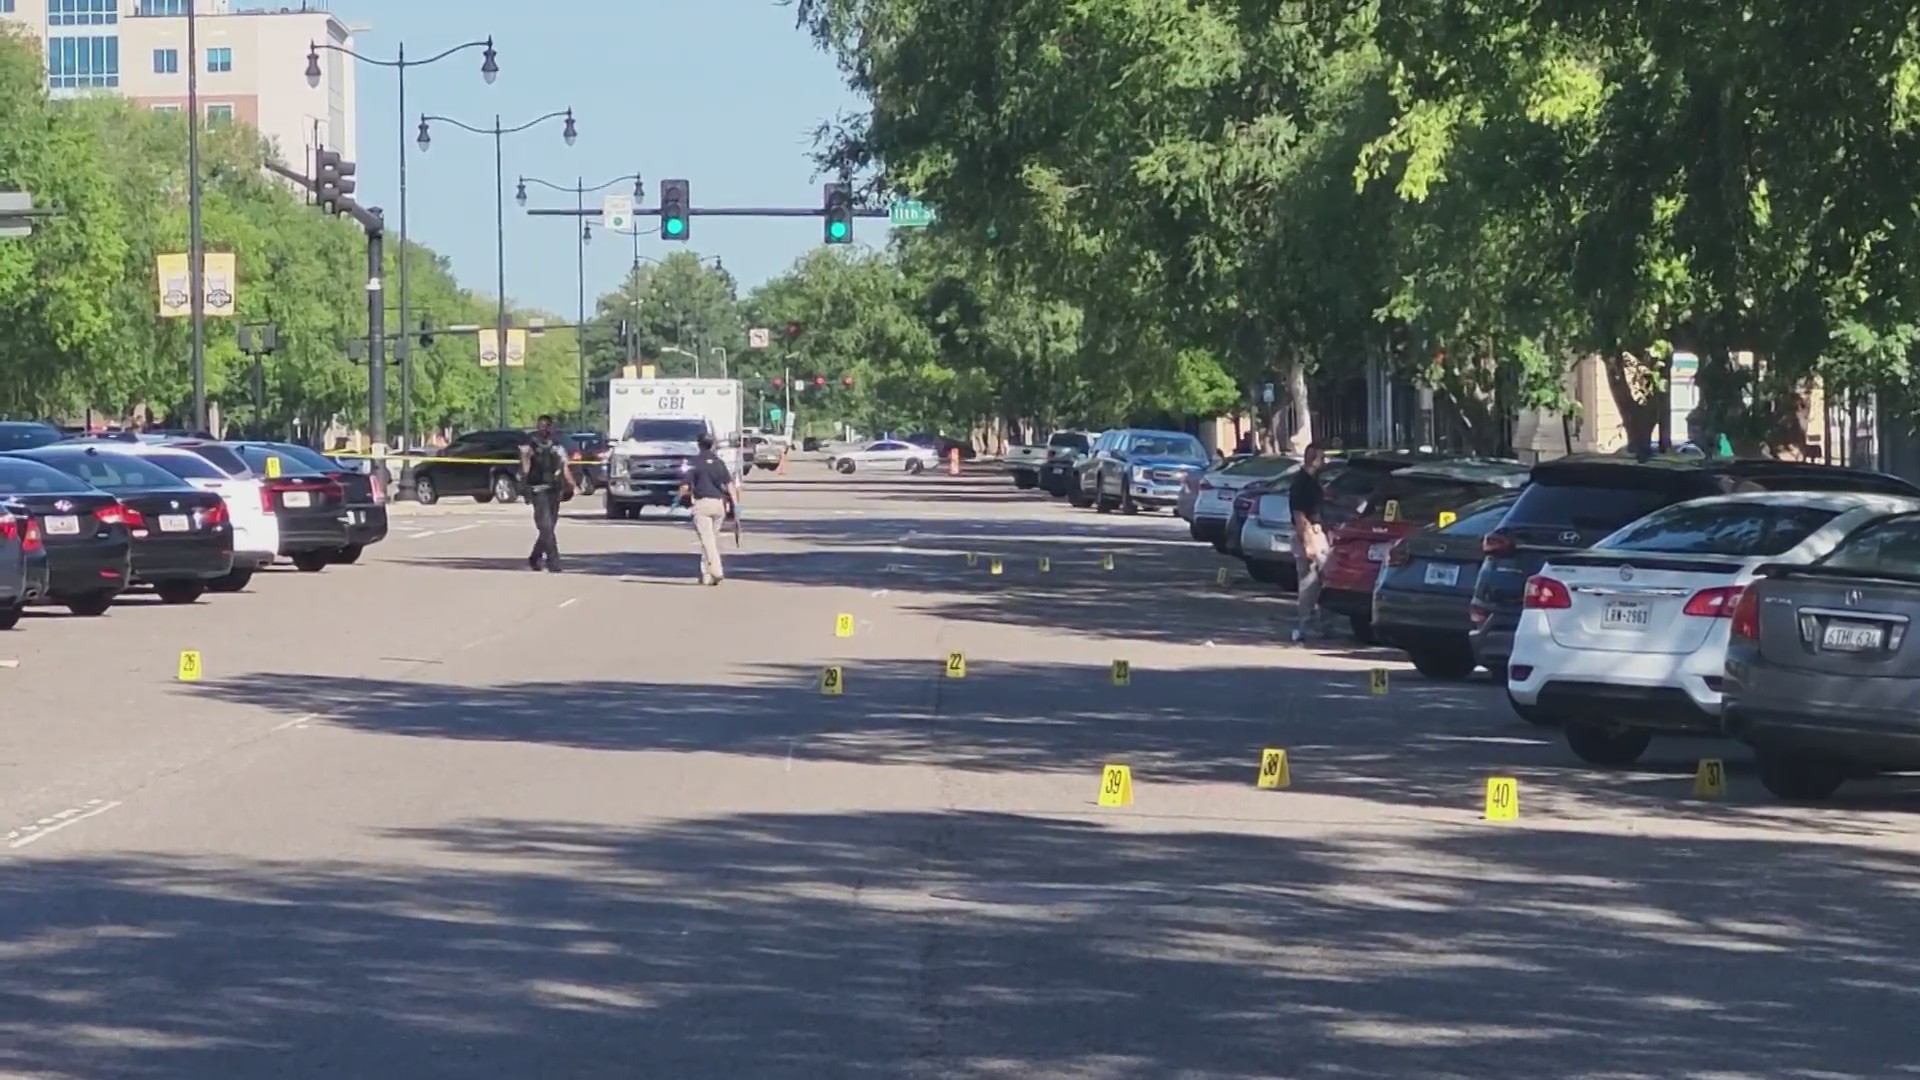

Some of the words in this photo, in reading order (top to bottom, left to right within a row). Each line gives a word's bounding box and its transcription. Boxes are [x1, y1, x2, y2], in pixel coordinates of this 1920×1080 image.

[895, 207, 918, 220] 11th
[658, 396, 685, 410] GBI
[183, 653, 197, 672] 26
[950, 653, 962, 670] 22
[824, 668, 838, 687] 29
[1263, 753, 1280, 777] 38
[1706, 761, 1720, 787] 37
[1105, 769, 1122, 795] 39
[1493, 783, 1510, 809] 40
